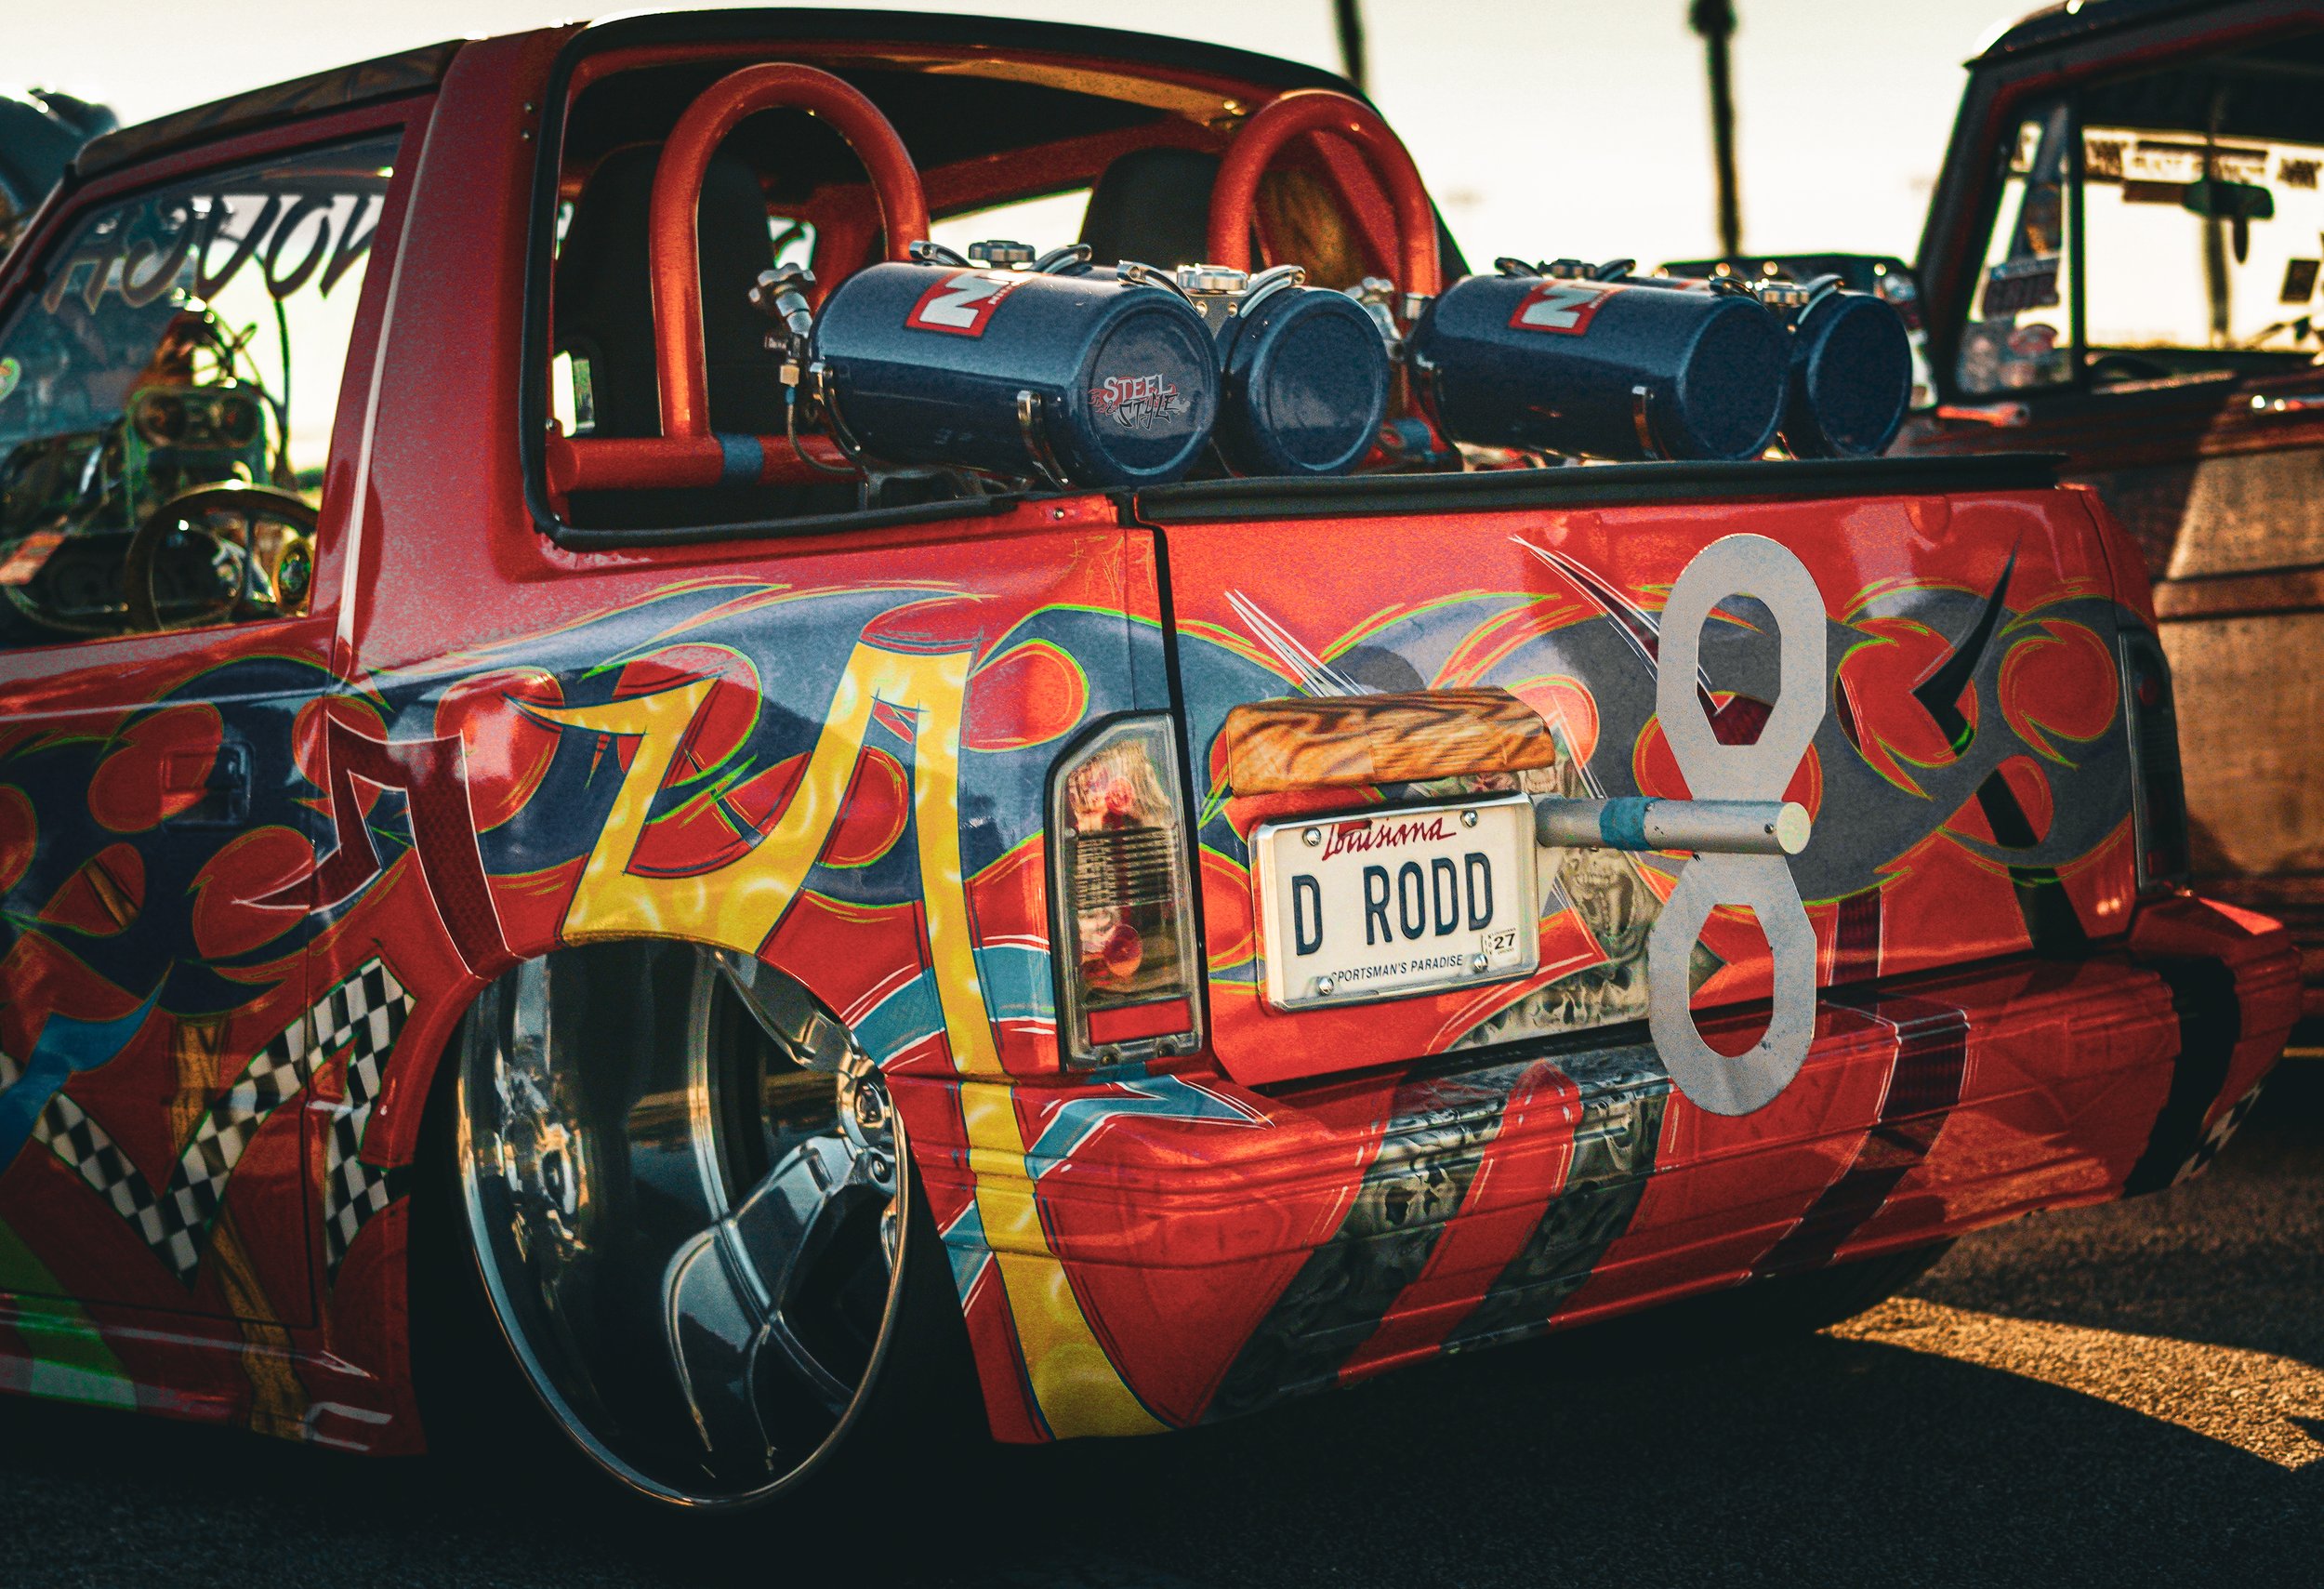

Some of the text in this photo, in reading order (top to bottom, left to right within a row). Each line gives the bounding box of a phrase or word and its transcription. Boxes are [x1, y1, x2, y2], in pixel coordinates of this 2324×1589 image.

[1103, 373, 1173, 404] STEEL
[1118, 392, 1181, 430] STYLE
[1322, 816, 1458, 861] Louisiana
[1291, 852, 1494, 956] D RODD
[1494, 933, 1515, 950] 27
[1411, 954, 1463, 973] PARADISE
